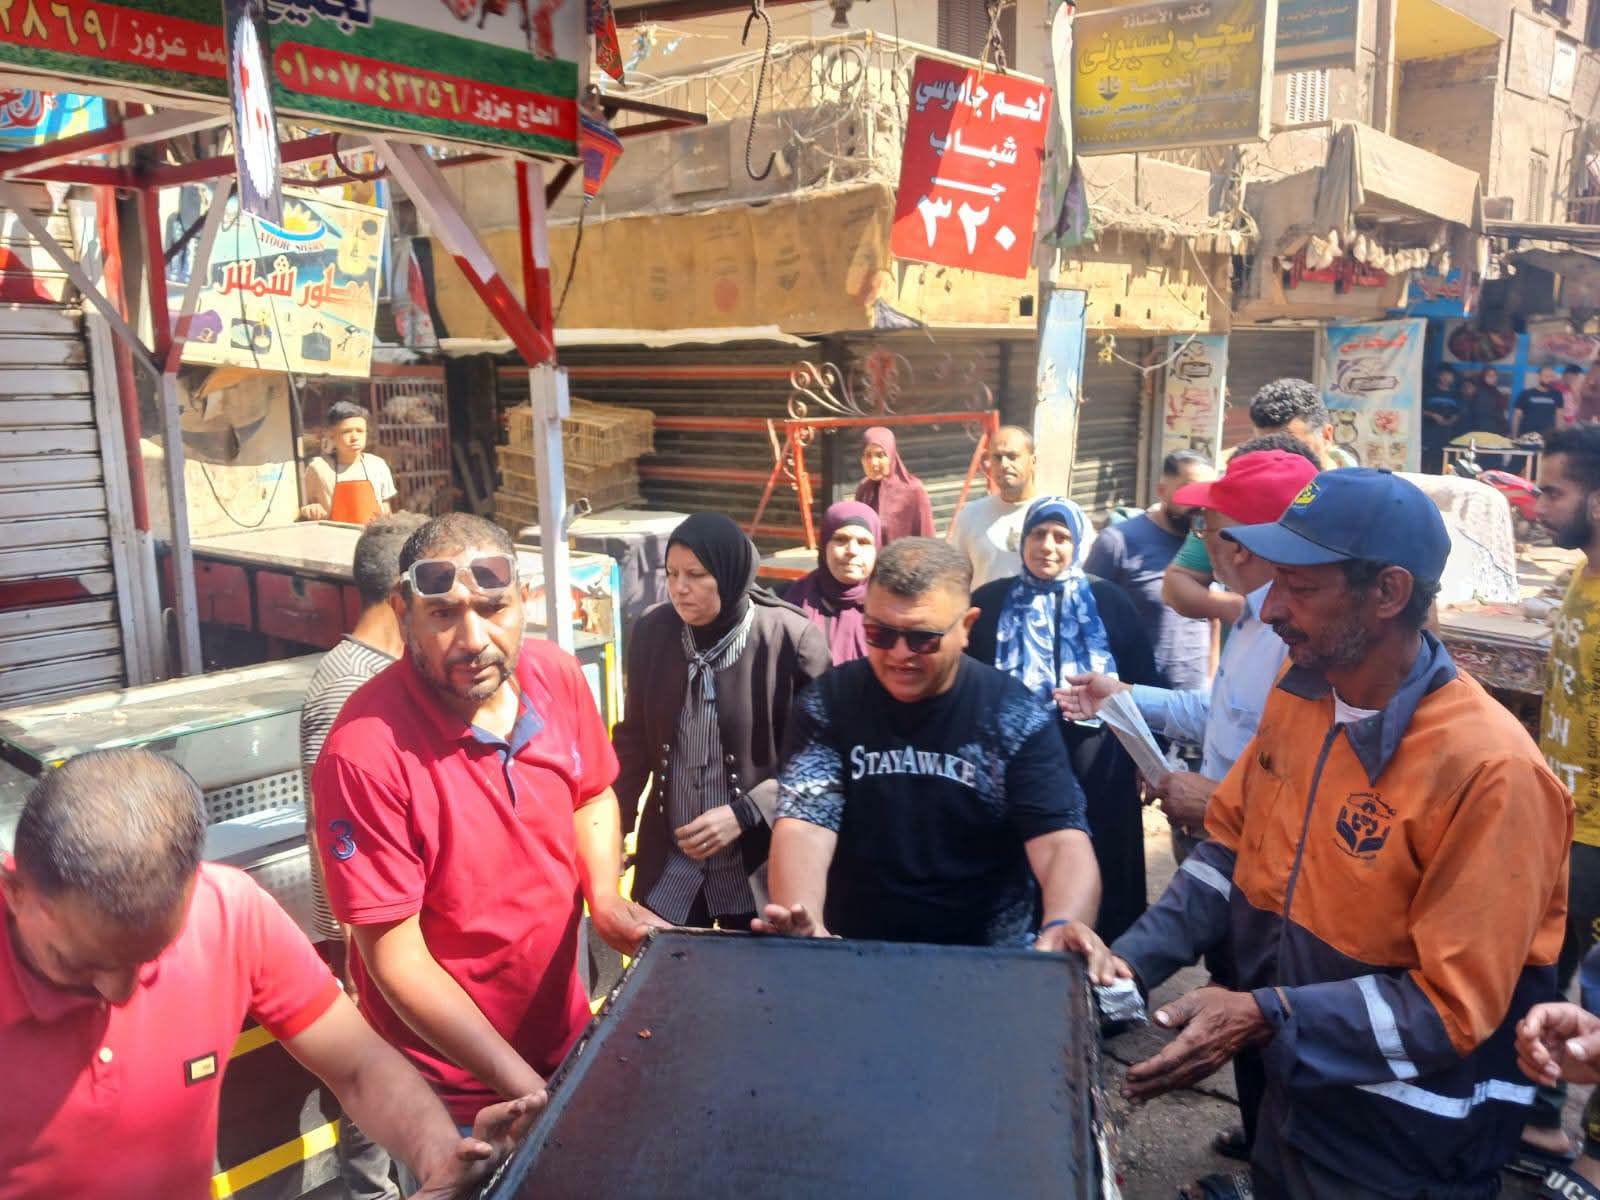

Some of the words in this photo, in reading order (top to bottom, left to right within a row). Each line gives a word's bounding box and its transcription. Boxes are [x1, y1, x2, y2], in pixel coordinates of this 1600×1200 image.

[128, 19, 188, 62] عزوز
[991, 91, 1045, 122] لحم
[929, 128, 1017, 168] شباب
[917, 195, 1017, 254] ٣٢٠
[330, 819, 357, 860] 3
